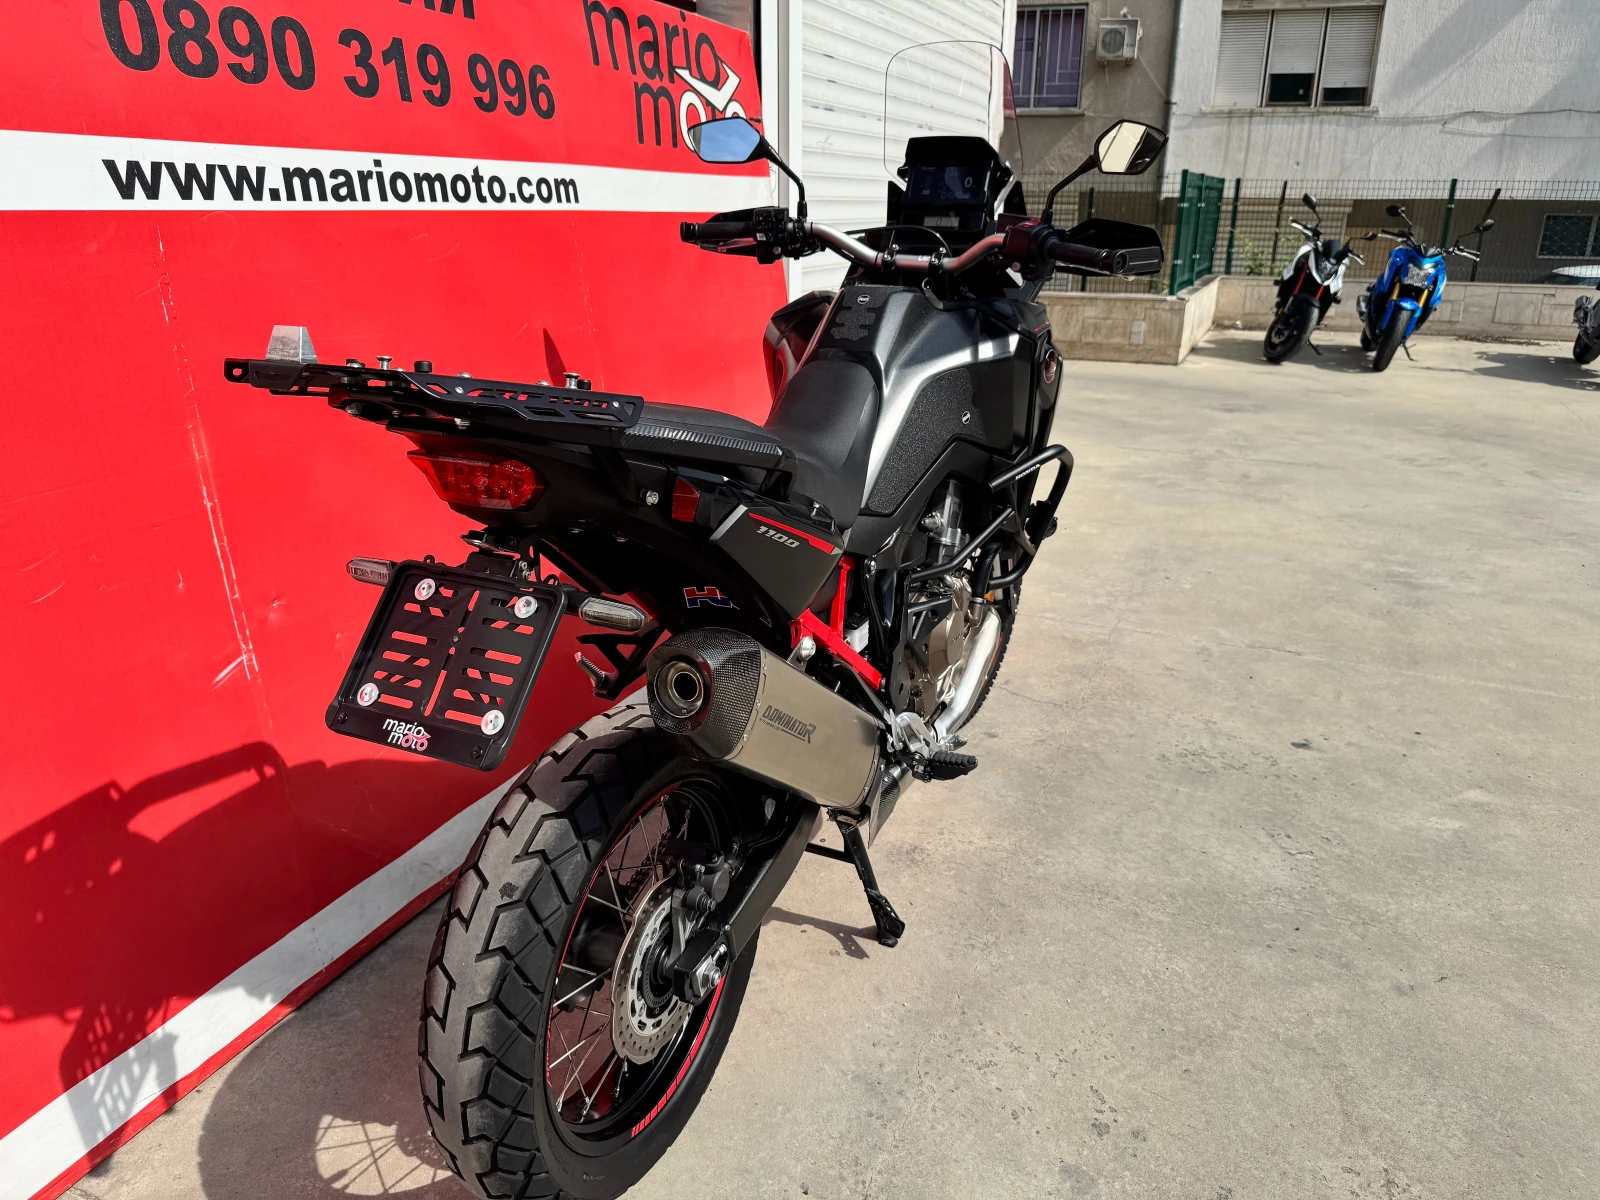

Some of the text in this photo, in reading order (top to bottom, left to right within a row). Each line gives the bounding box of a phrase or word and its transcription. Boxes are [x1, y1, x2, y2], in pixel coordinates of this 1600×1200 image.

[101, 0, 556, 120] 0890 319 996
[582, 0, 721, 89] mario
[101, 159, 580, 204] www.mariomoto.com
[755, 525, 801, 549] 1100
[382, 718, 425, 738] mario
[387, 731, 429, 752] moto
[761, 704, 817, 744] DOMINATOR
